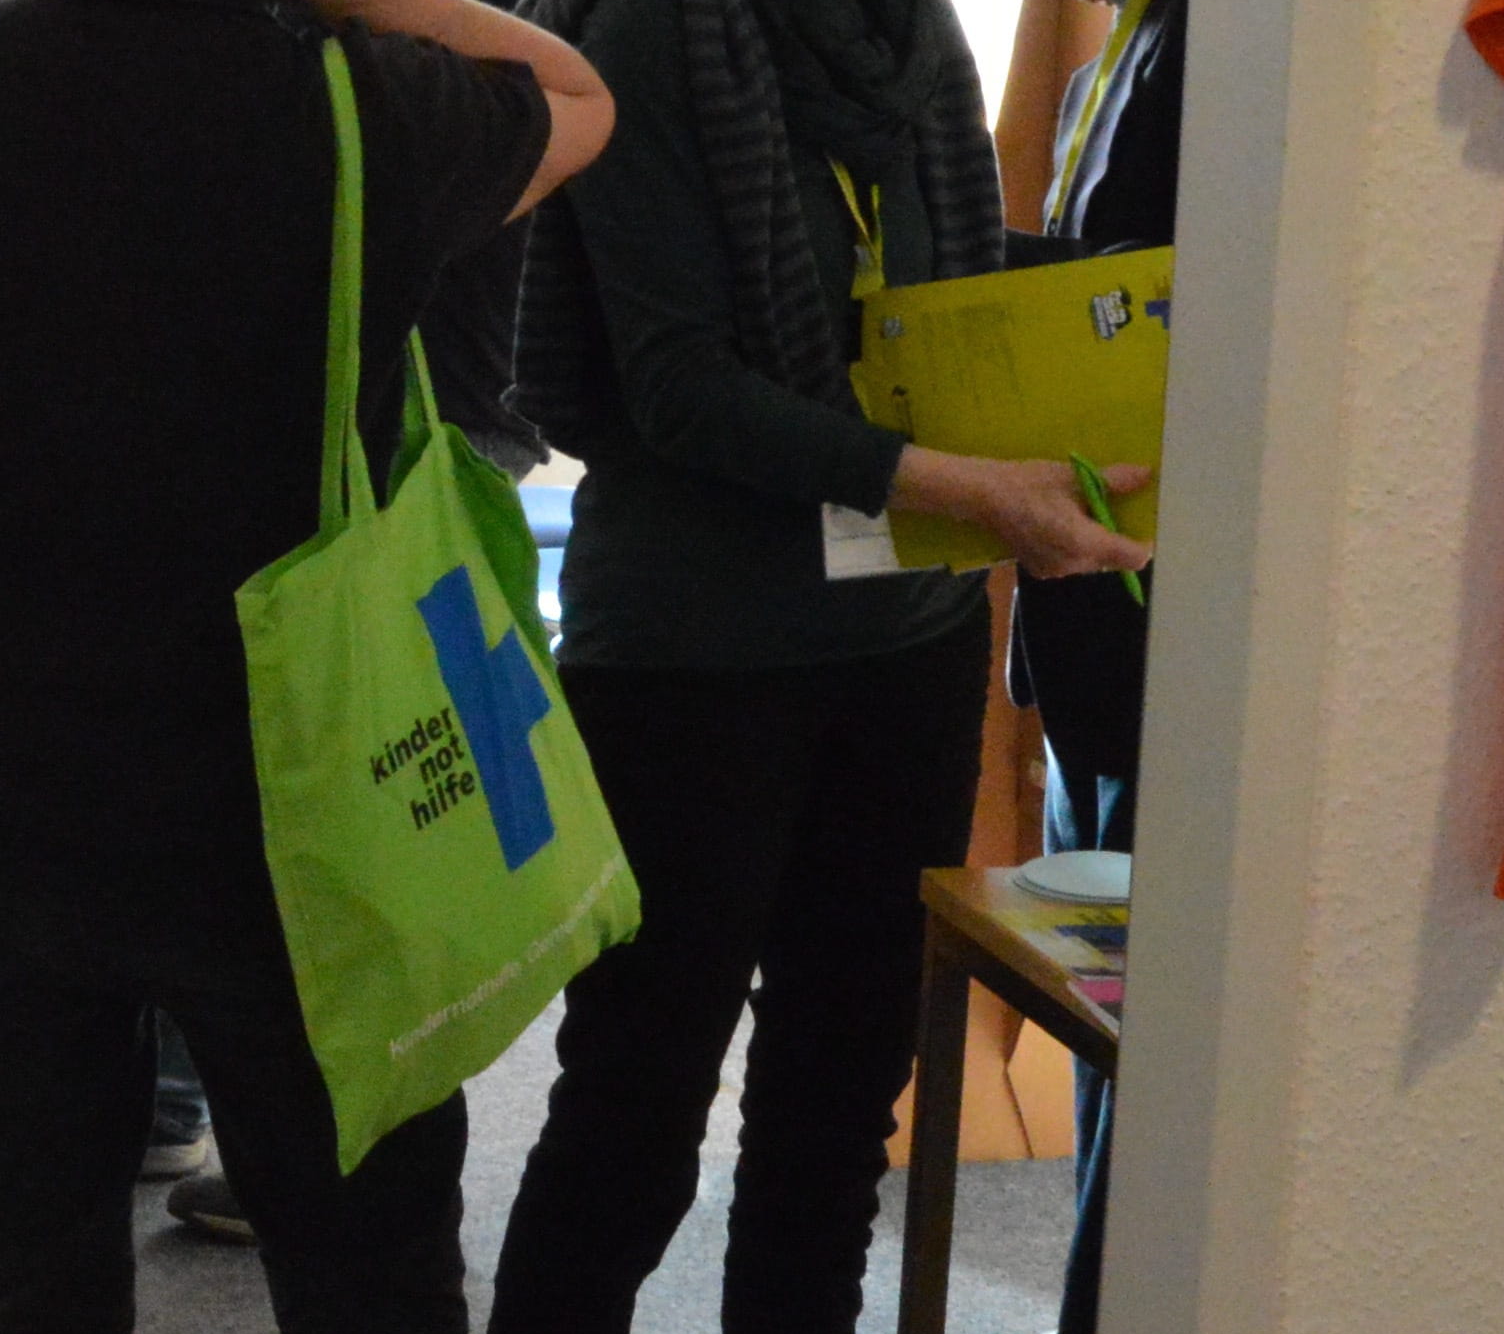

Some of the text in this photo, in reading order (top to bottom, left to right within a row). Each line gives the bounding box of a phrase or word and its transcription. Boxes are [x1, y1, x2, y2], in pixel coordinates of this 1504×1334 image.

[370, 707, 453, 785] kinder
[418, 732, 465, 785] not
[410, 770, 476, 830] hilfe
